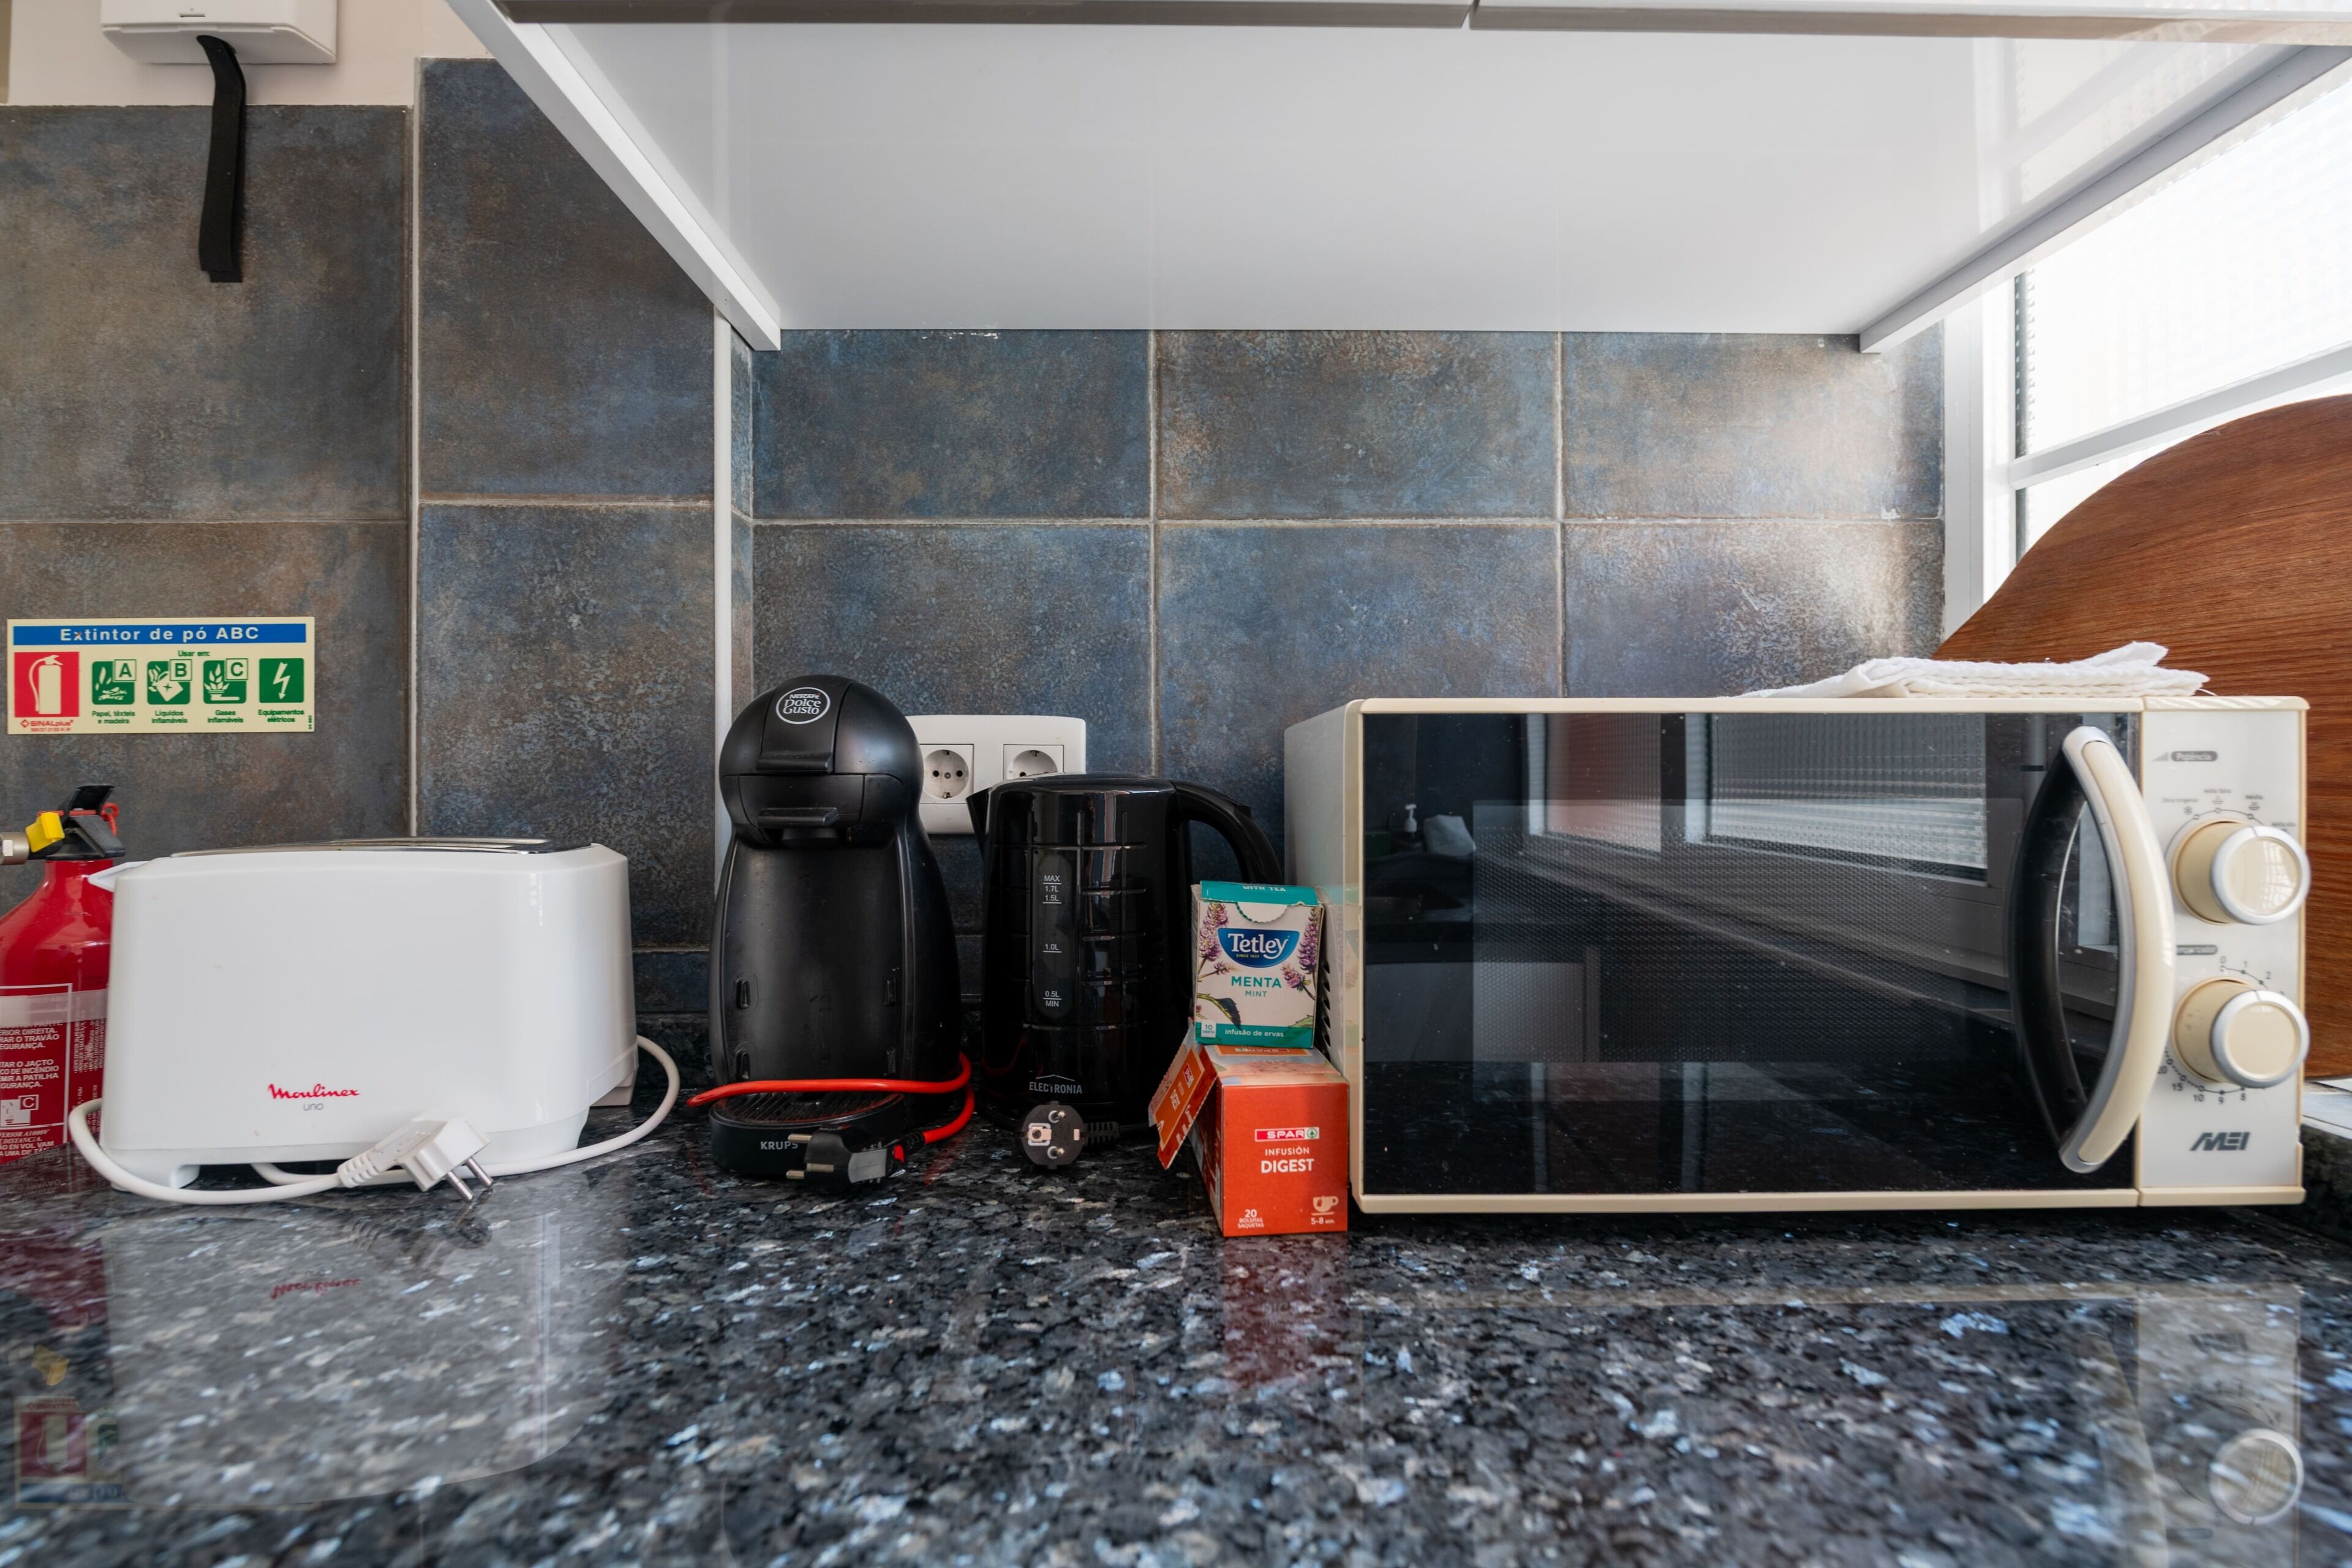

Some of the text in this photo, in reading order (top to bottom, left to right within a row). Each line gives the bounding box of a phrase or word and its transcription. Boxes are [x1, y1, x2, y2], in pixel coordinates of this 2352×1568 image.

[59, 627, 259, 643] Extintor de pó ABC
[119, 663, 132, 677] A
[175, 663, 187, 677] B
[230, 662, 244, 676] C
[784, 698, 821, 707] Dolce
[783, 706, 820, 715] Gusto
[1227, 933, 1289, 960] Tetley
[1231, 976, 1282, 989] MENTA
[23, 1072, 59, 1081] PATILHA
[267, 1083, 361, 1099] Moulinex
[22, 1097, 35, 1108] C
[2193, 1093, 2204, 1102] 10
[303, 1102, 324, 1111] uno
[1267, 1129, 1304, 1139] SPAR
[760, 1141, 799, 1150] KRUPS
[1265, 1145, 1310, 1156] INFUSIÓN
[1261, 1158, 1314, 1174] DIGEST
[1245, 1208, 1257, 1218] 20
[1311, 1216, 1324, 1225] 5-8
